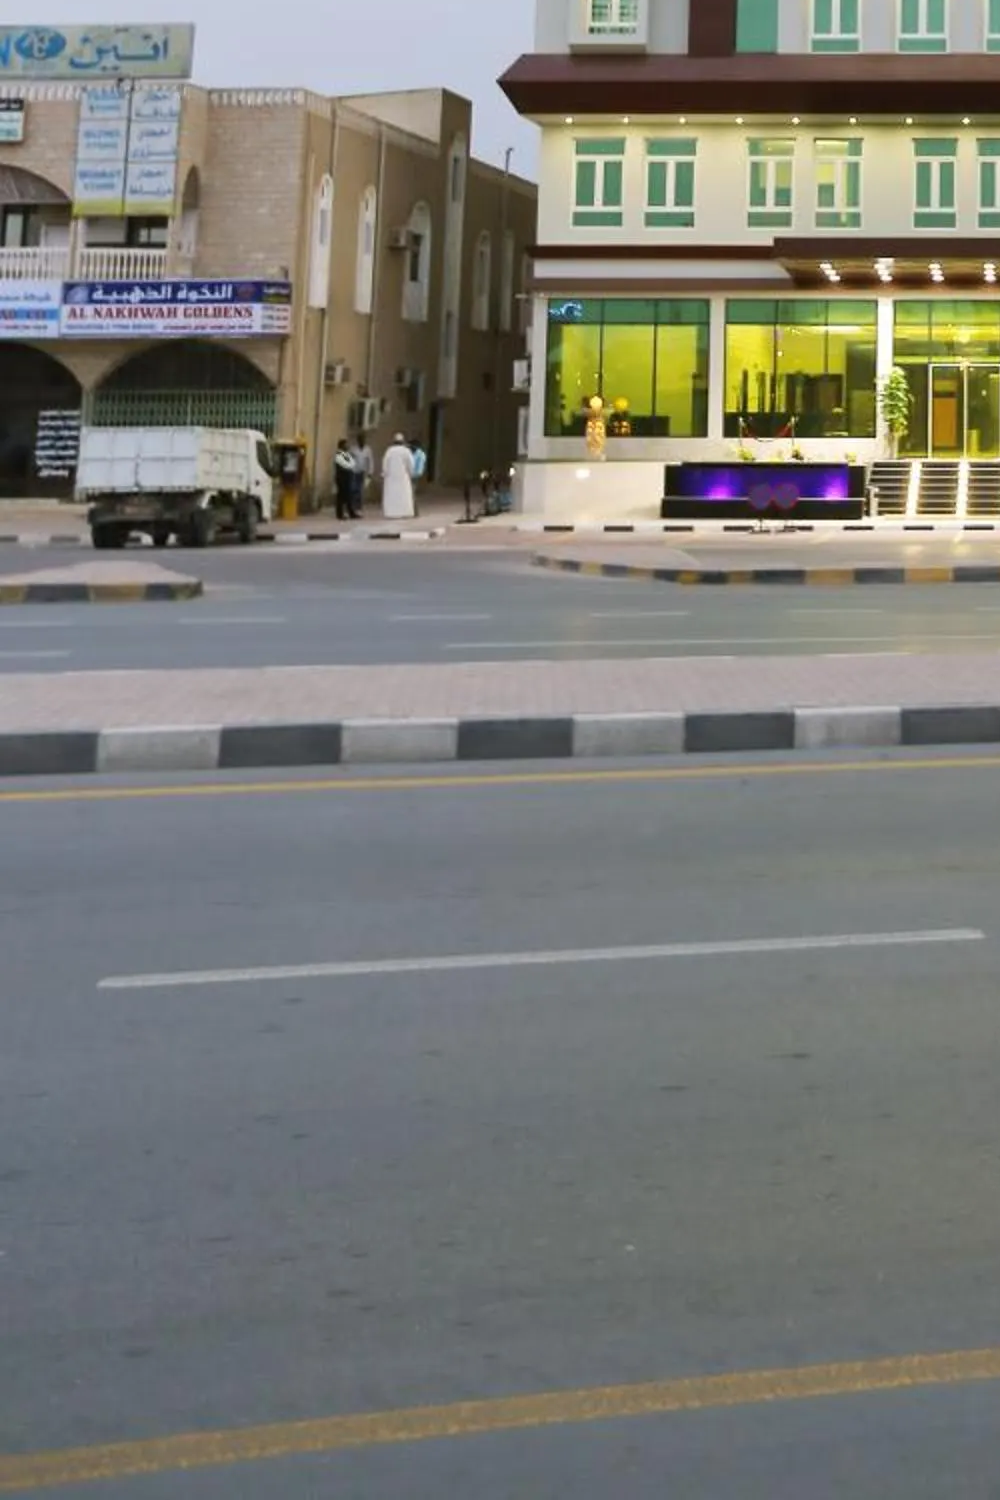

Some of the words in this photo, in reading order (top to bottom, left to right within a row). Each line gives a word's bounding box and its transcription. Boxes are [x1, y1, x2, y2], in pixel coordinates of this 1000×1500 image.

[67, 307, 86, 319] AL
[93, 307, 178, 319] NAKHWAH
[183, 307, 253, 318] GOLDENS
